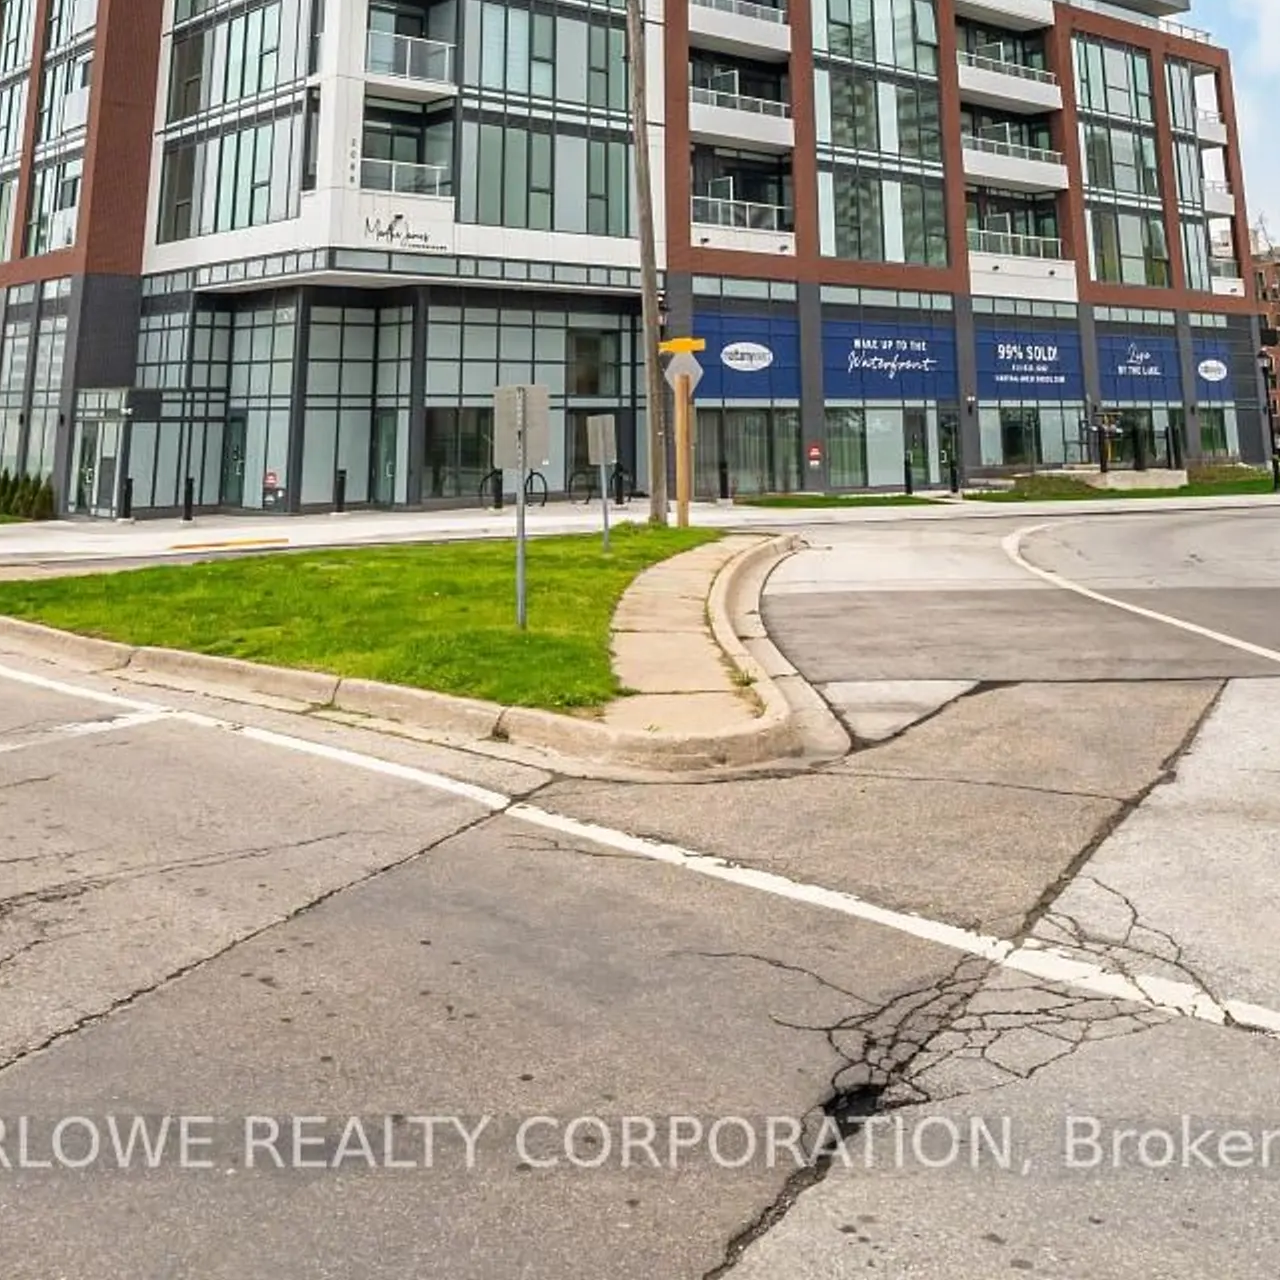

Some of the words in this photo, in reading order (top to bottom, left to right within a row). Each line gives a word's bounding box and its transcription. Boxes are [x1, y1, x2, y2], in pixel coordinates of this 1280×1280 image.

[880, 339, 894, 351] UP
[895, 339, 908, 352] TO
[997, 343, 1024, 360] 99%
[847, 349, 938, 380] Waterfront
